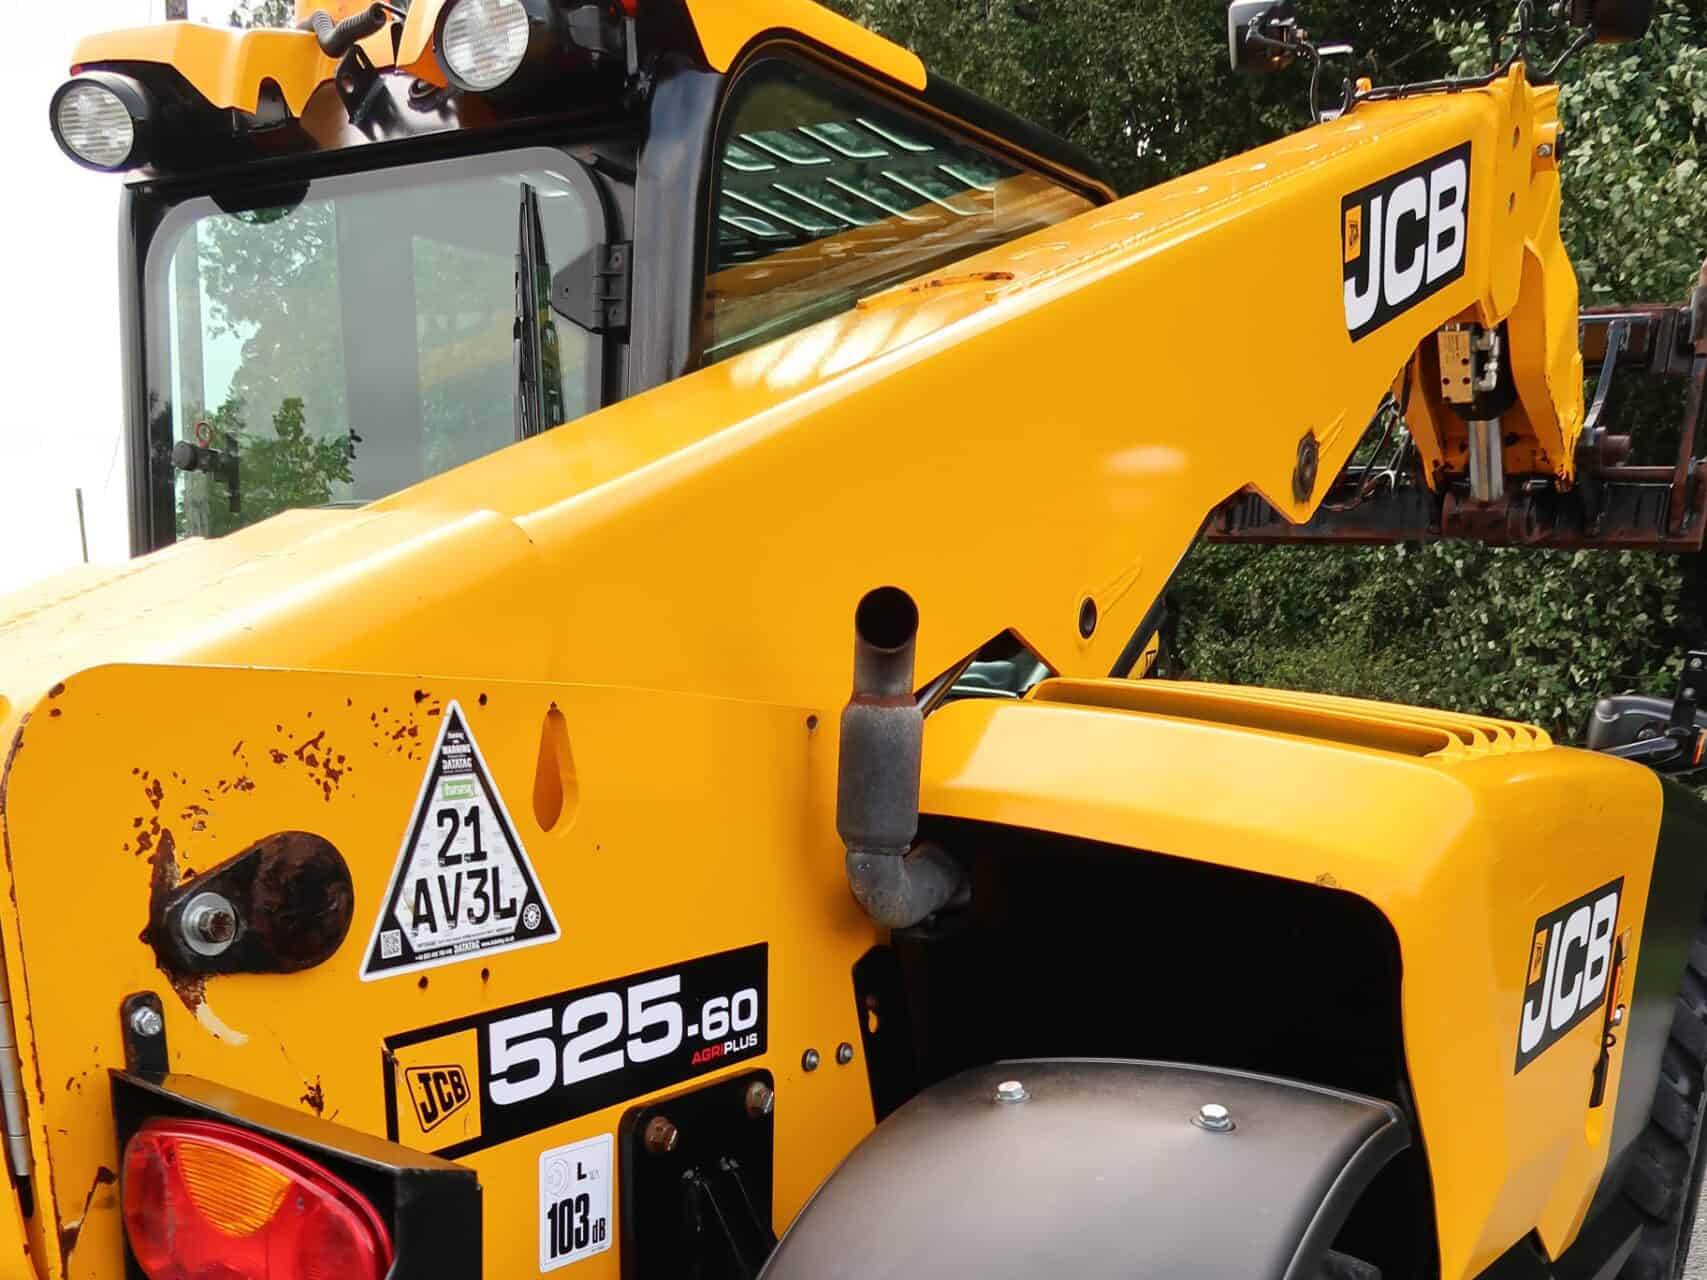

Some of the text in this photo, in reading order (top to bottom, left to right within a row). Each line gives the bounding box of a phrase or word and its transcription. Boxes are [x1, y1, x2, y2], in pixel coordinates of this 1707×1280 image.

[1343, 158, 1467, 331] JCB
[436, 805, 488, 868] 21
[411, 866, 517, 937] AV3L
[1520, 892, 1619, 1054] JCB
[416, 1070, 468, 1124] JCB
[576, 1161, 588, 1181] L
[547, 1193, 606, 1260] 103 dB
